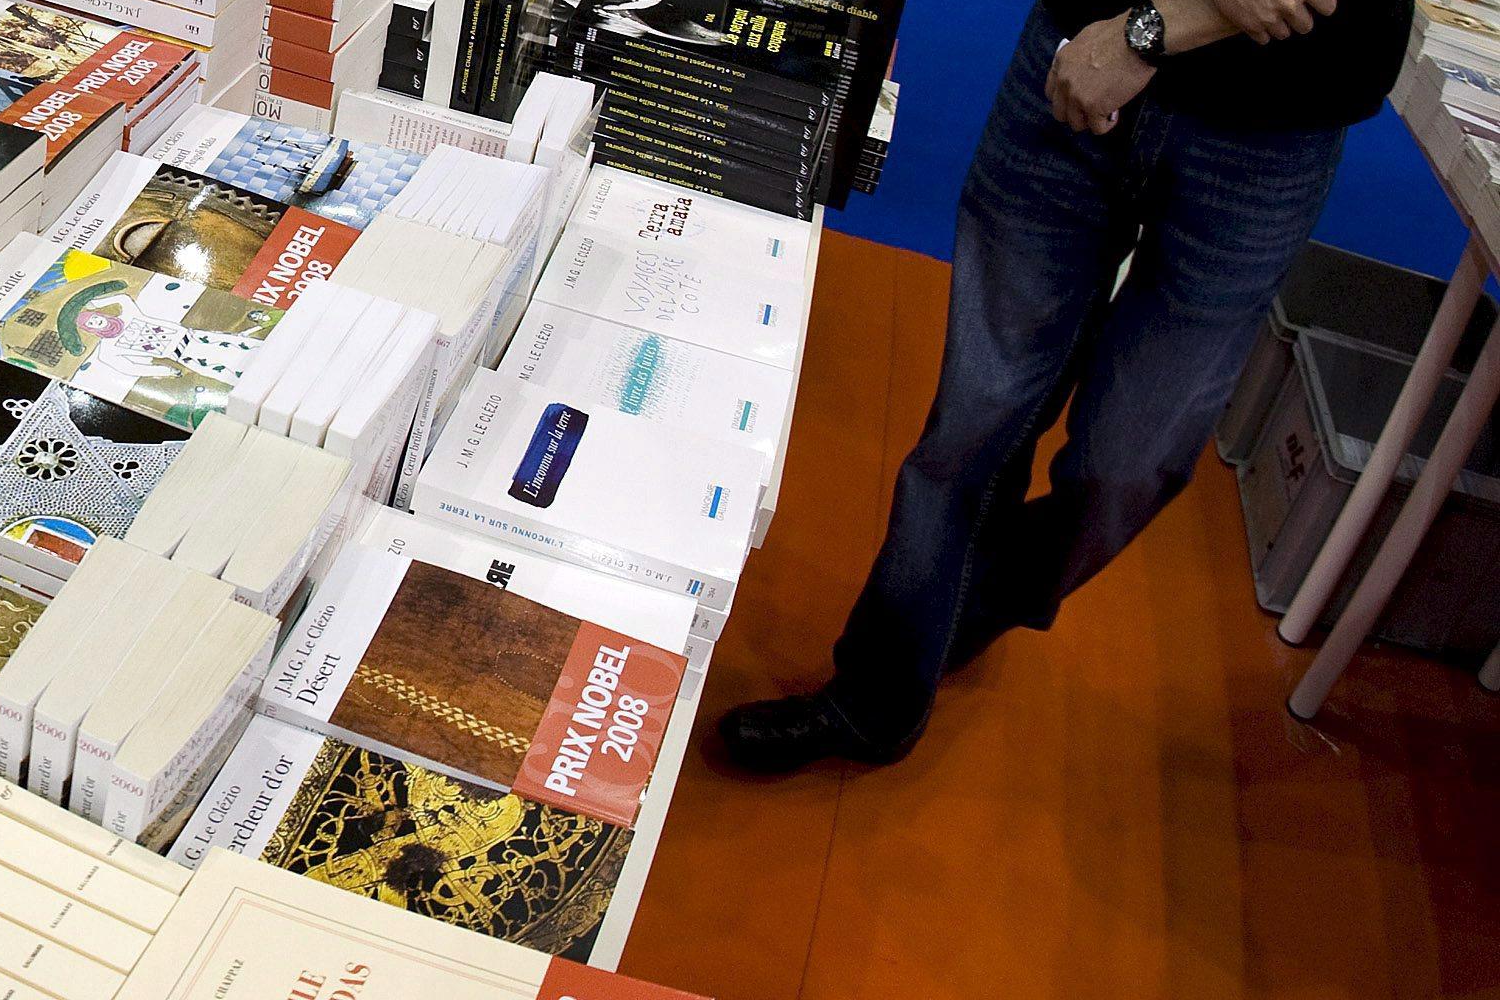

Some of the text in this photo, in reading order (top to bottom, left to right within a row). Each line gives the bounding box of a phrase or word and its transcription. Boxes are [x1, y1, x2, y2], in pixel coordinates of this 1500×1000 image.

[720, 7, 750, 46] Le serpent
[831, 1, 845, 12] du
[846, 5, 879, 21] diable
[746, 14, 768, 49] aux mille
[766, 20, 788, 53] coupures
[76, 38, 154, 96] PRIX NOBEL
[116, 57, 158, 88] 2008
[32, 89, 80, 128] NOBEL
[45, 110, 83, 144] 2008
[638, 203, 670, 241] Terra
[666, 197, 694, 237] amata
[272, 223, 326, 283] NOBEL
[623, 249, 660, 314] VOYAGES
[522, 452, 554, 499] L'inconnu
[547, 437, 560, 455] sur
[554, 410, 572, 431] terre
[438, 501, 564, 549] L'INCONNU SUR LA TERRE
[295, 653, 342, 707] Désert
[543, 643, 632, 797] PRIX NOBEL
[599, 694, 650, 764] 2008
[76, 735, 112, 764] 2000
[109, 773, 145, 799] 2000
[268, 753, 296, 792] d'or
